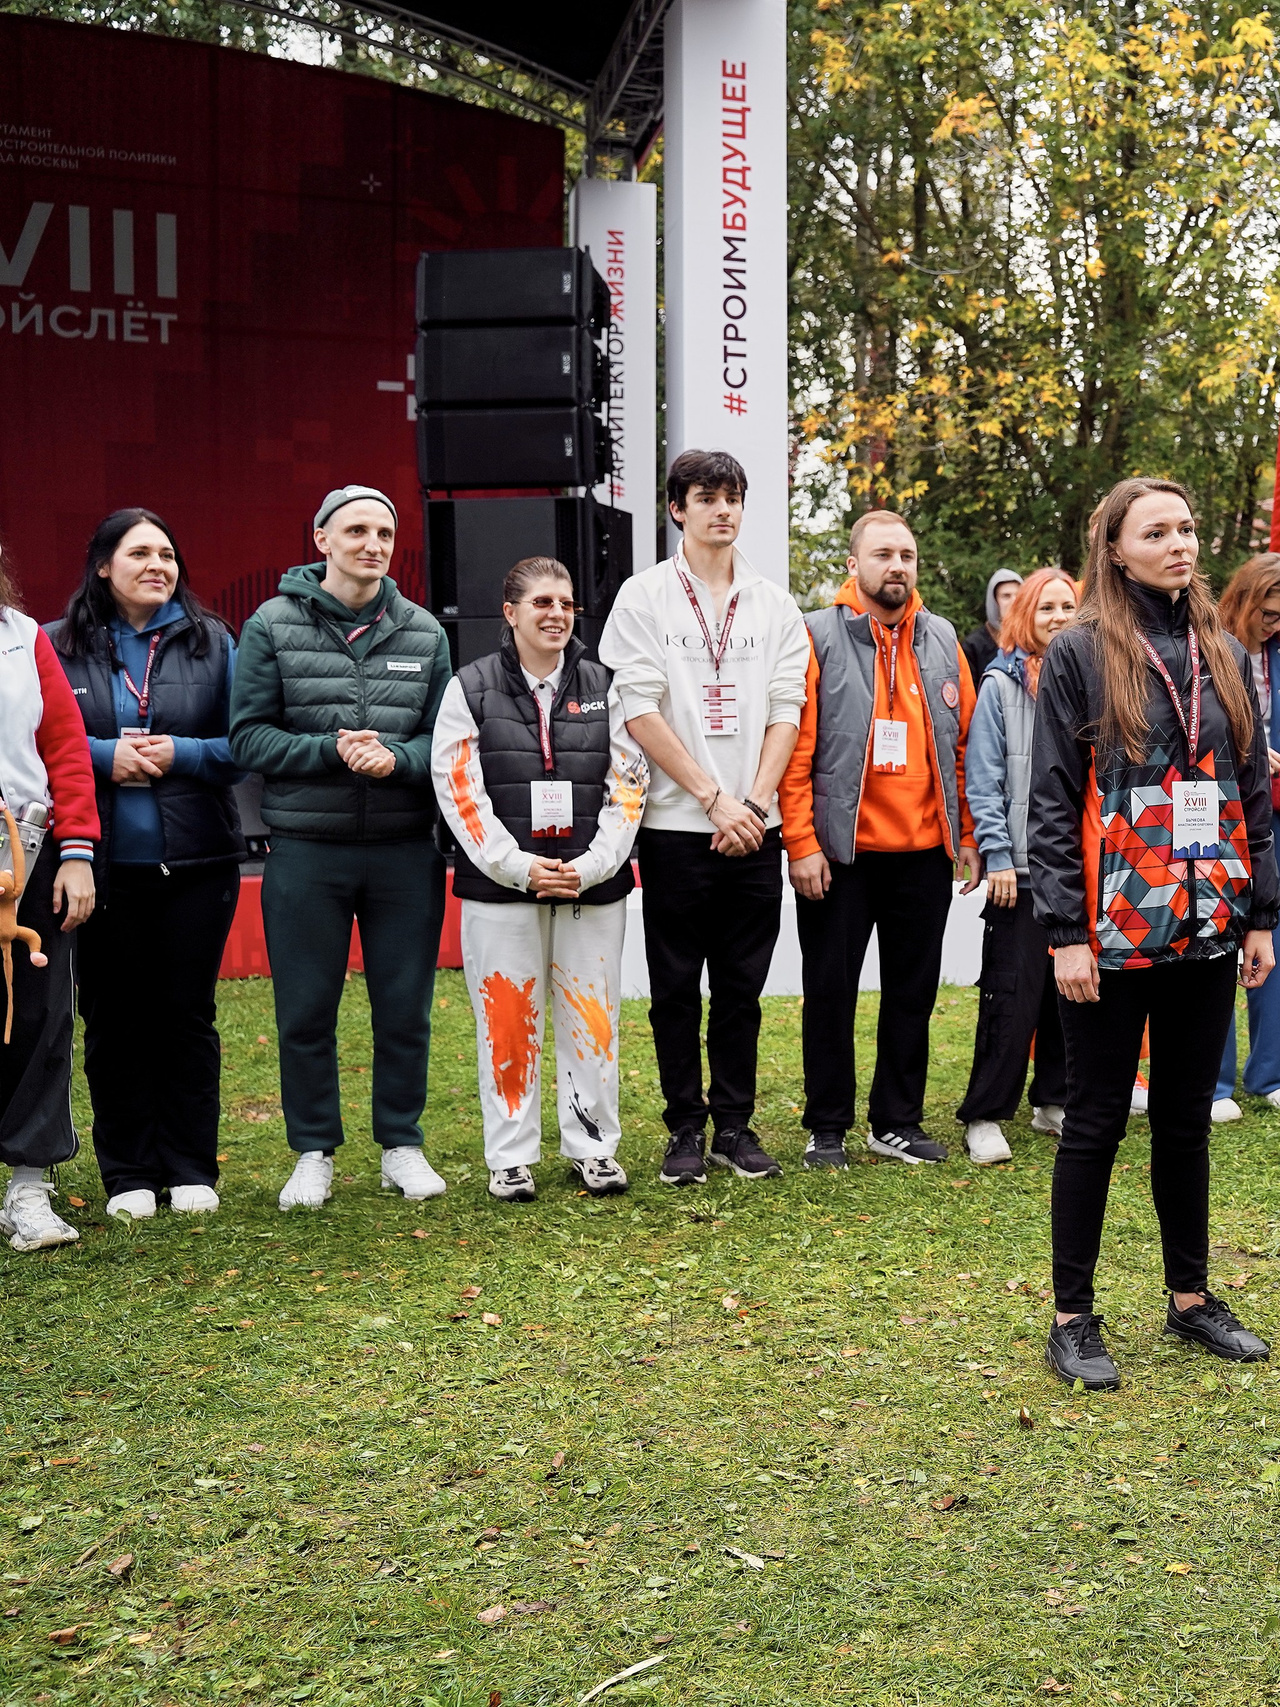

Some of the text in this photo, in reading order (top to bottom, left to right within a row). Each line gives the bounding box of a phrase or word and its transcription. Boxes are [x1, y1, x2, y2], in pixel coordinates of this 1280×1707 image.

[0, 123, 52, 138] ТАМЕНТ
[0, 138, 177, 166] СТРОИТЕЛЬНОЙ ПОЛИТИКИ
[19, 154, 79, 170] МОСКВЫ
[722, 59, 751, 416] #СТРОИМБУДУЩЕЕ
[0, 291, 178, 345] ЙСЛЁТ
[581, 700, 606, 714] ФСК
[1190, 698, 1198, 735] ФУНДАМЕНТ
[1184, 797, 1207, 806] XVIII
